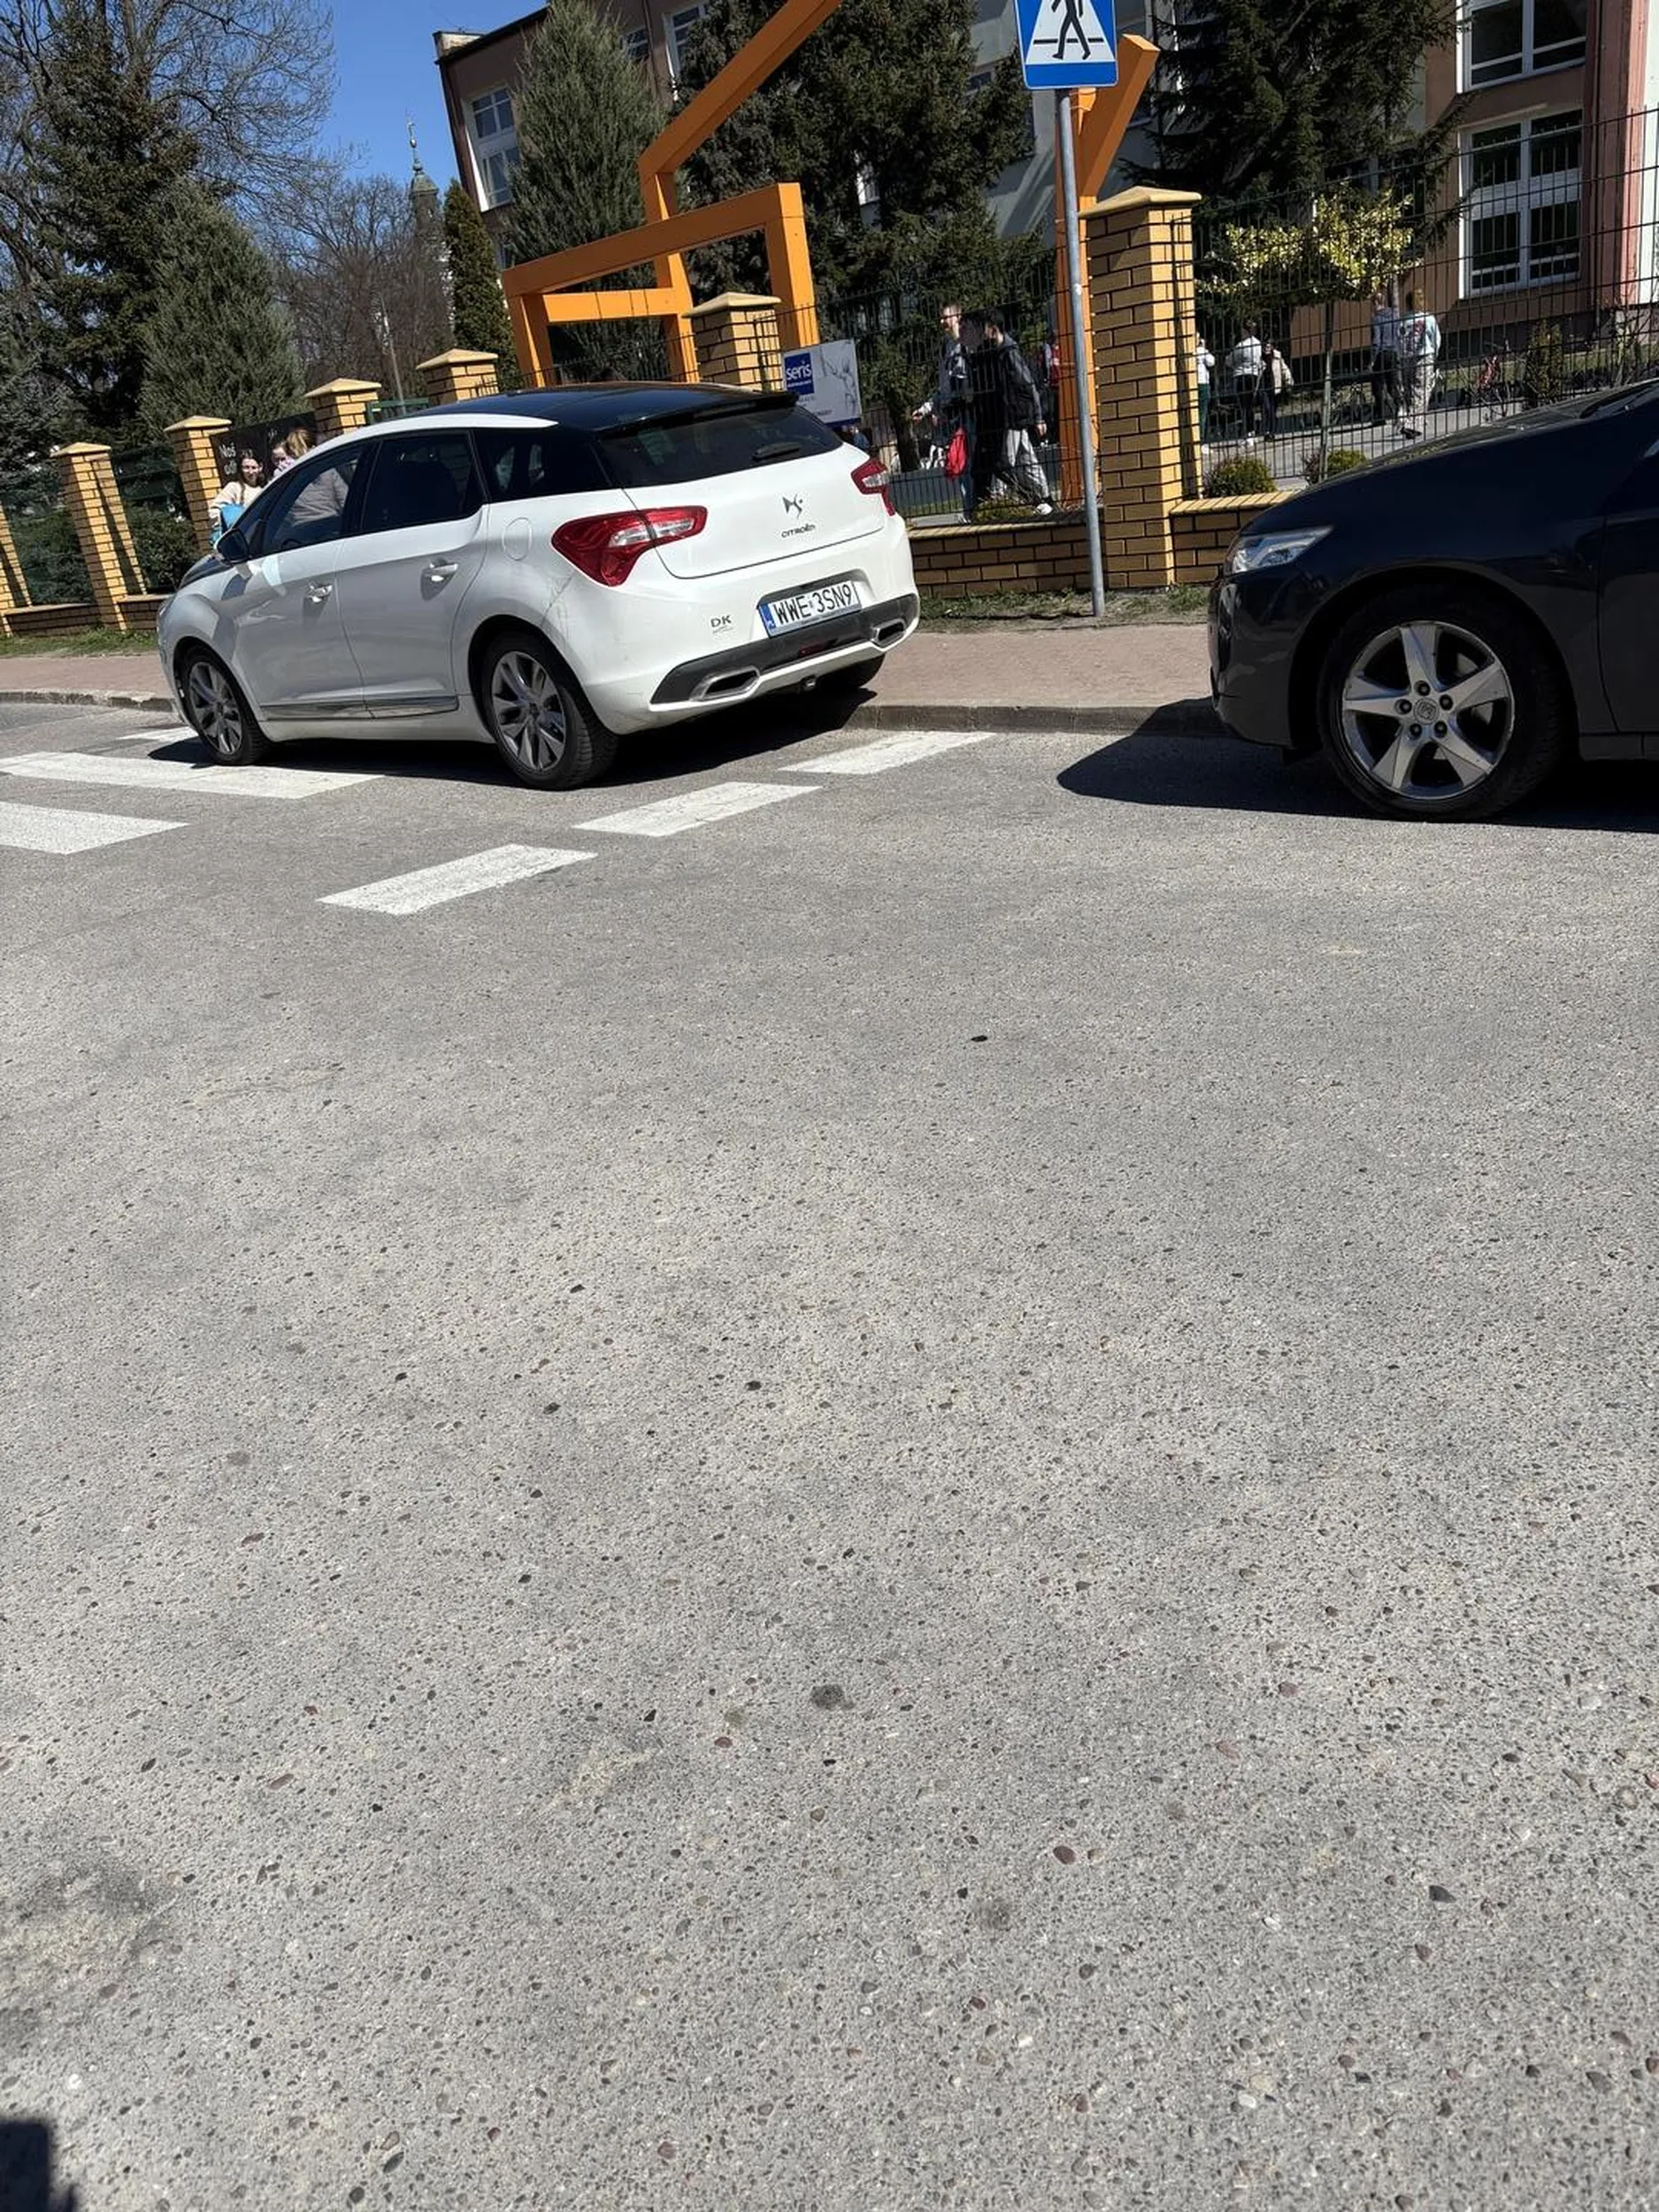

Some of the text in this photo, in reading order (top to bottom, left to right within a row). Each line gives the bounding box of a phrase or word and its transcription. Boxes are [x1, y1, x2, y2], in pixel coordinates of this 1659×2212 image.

[786, 359, 812, 380] seris
[772, 584, 852, 625] WWE 3SN9
[710, 614, 732, 627] DK
